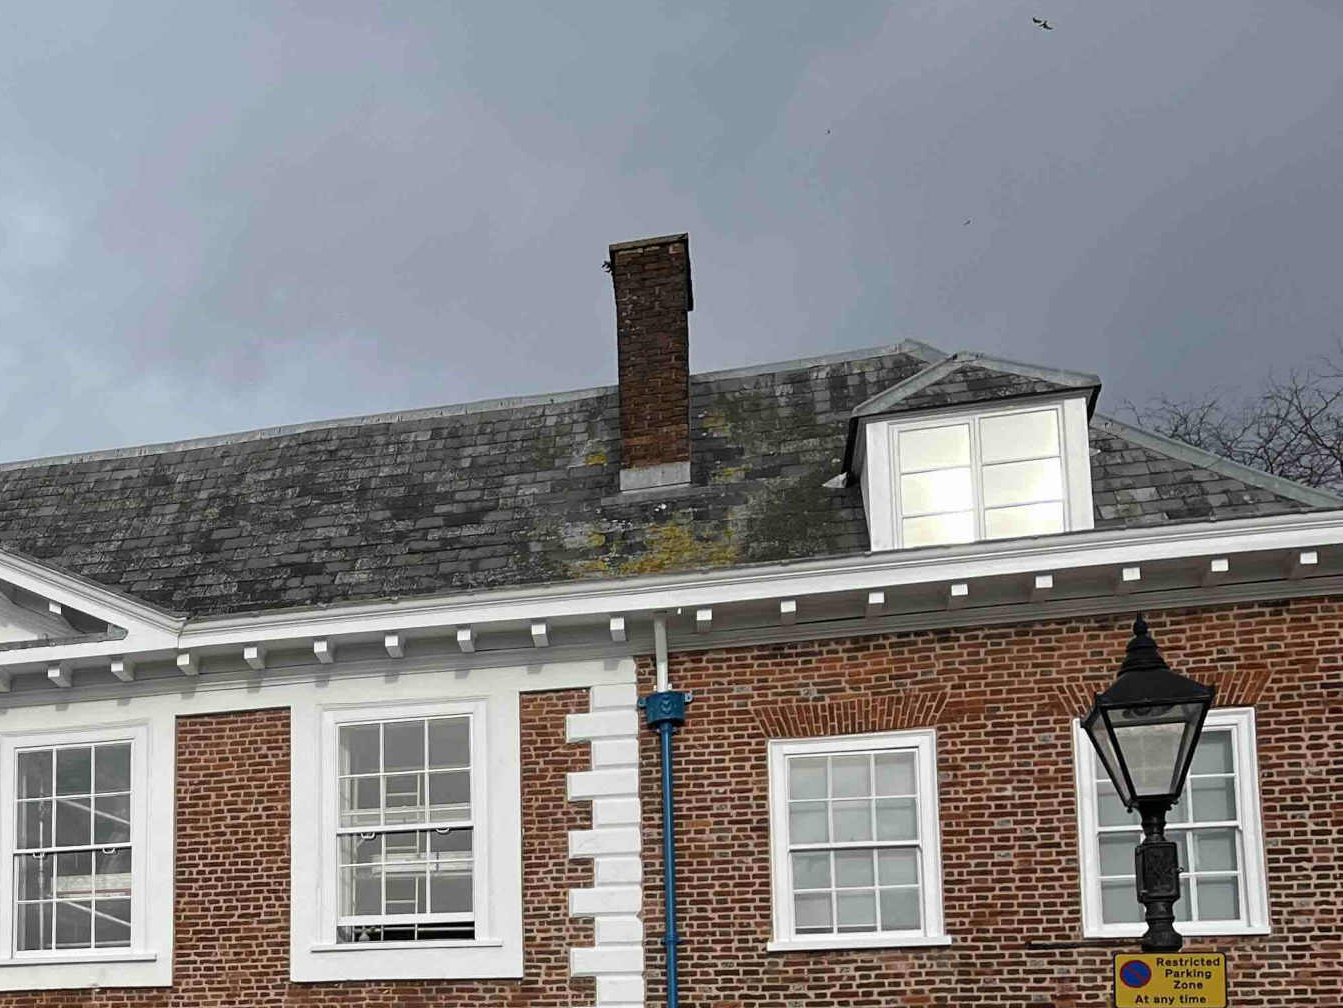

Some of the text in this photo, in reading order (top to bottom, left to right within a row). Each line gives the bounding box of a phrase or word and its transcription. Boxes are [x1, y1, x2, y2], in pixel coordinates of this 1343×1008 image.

[1156, 957, 1220, 967] Restricted
[1165, 969, 1212, 979] Parking
[1173, 980, 1204, 990] Zone
[1135, 994, 1207, 1005] At any time
